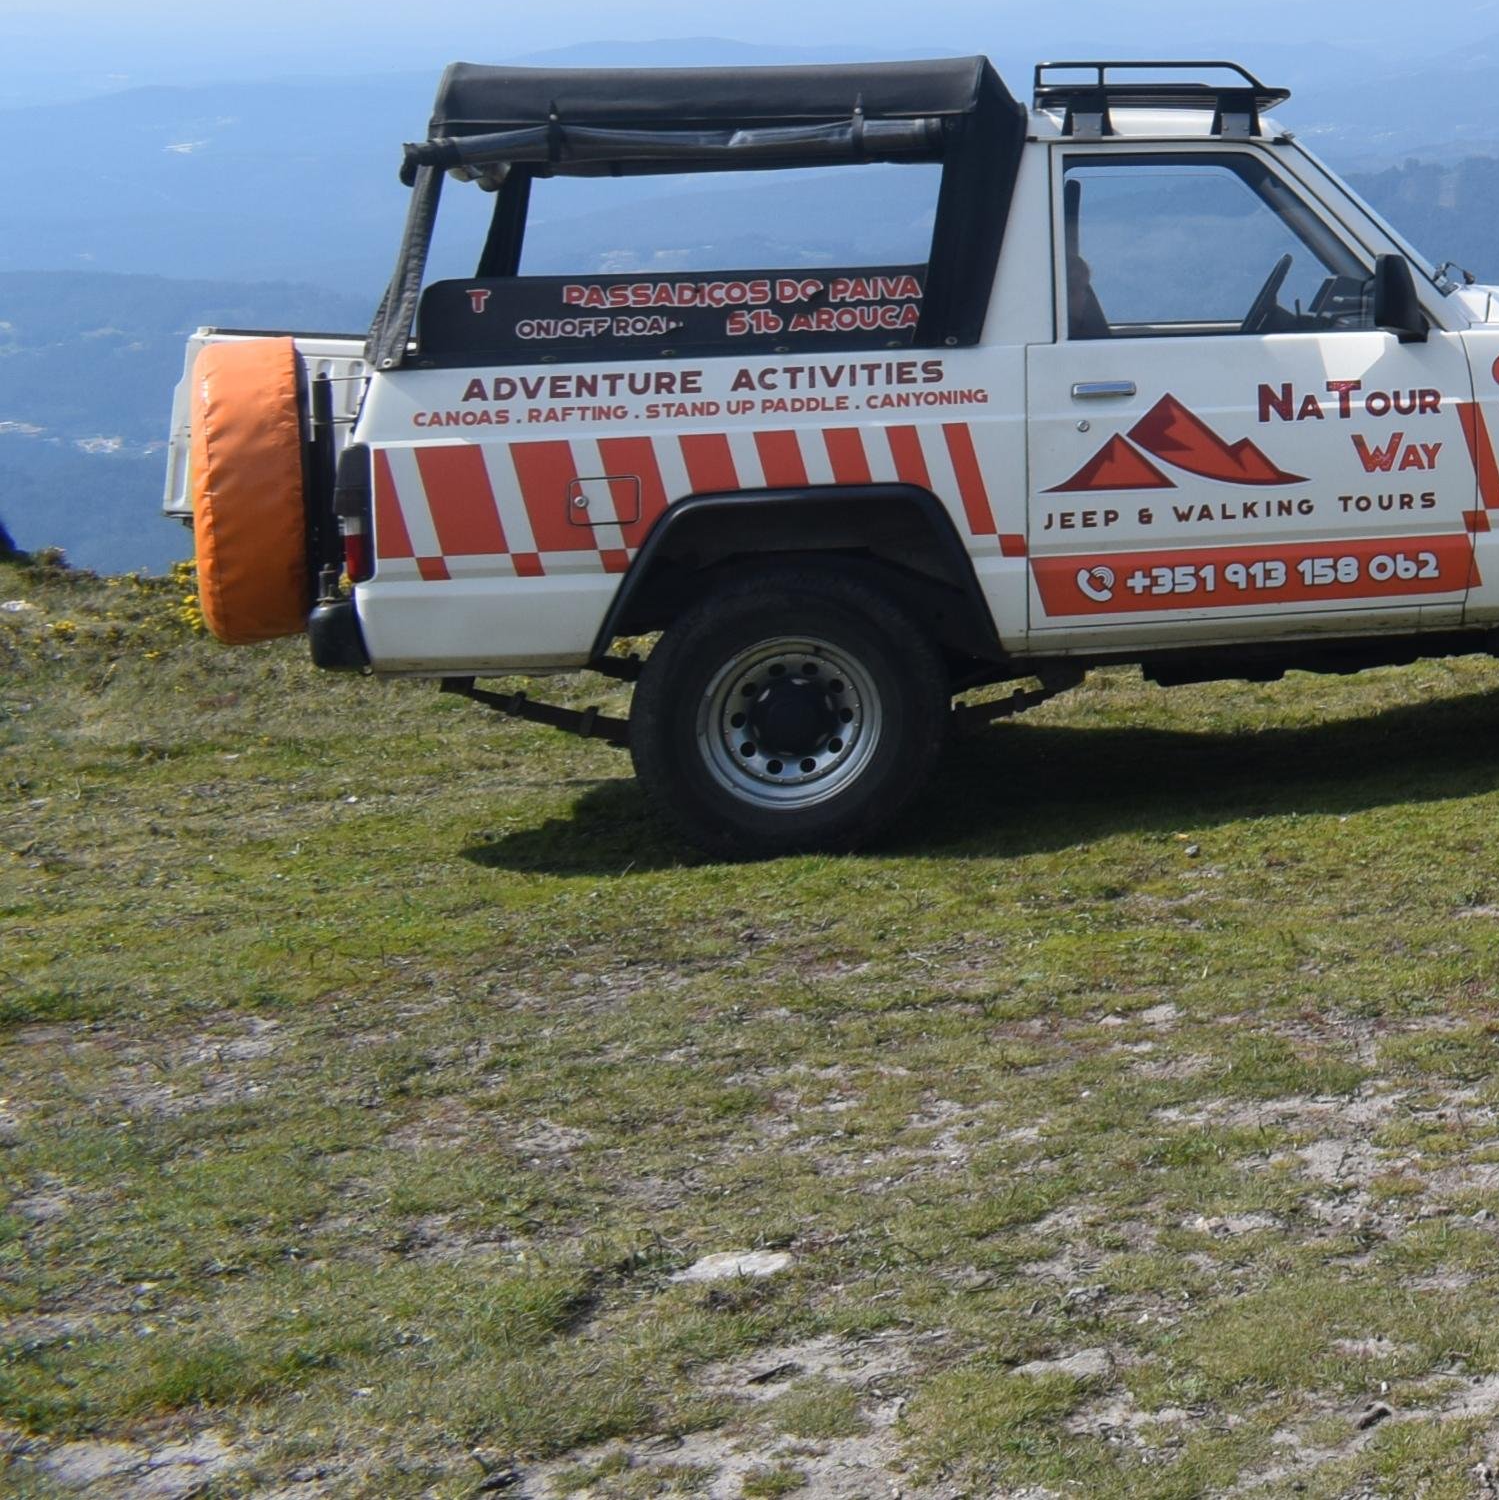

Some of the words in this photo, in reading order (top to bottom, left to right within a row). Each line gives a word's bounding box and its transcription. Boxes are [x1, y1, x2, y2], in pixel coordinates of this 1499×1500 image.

[563, 280, 770, 307] PASSADIÇOS
[830, 275, 923, 303] PAIVA
[516, 317, 610, 339] ON/OFF
[788, 304, 920, 332] AROUCA
[461, 370, 703, 402] ADVENTURE
[730, 360, 944, 392] ACTIVITIES
[412, 409, 510, 427] CANOAS
[527, 405, 628, 423] RAFTING
[645, 400, 720, 419] STAND
[726, 399, 755, 416] UP
[761, 396, 850, 414] PADDLE
[865, 389, 989, 410] CANYONING
[1044, 509, 1120, 530] JEEP
[1137, 507, 1152, 525] &
[1172, 498, 1315, 523] WALKING
[1337, 492, 1437, 513] TOURS
[1126, 564, 1216, 595] +351
[1224, 560, 1286, 589] 913
[1297, 556, 1359, 585] 158
